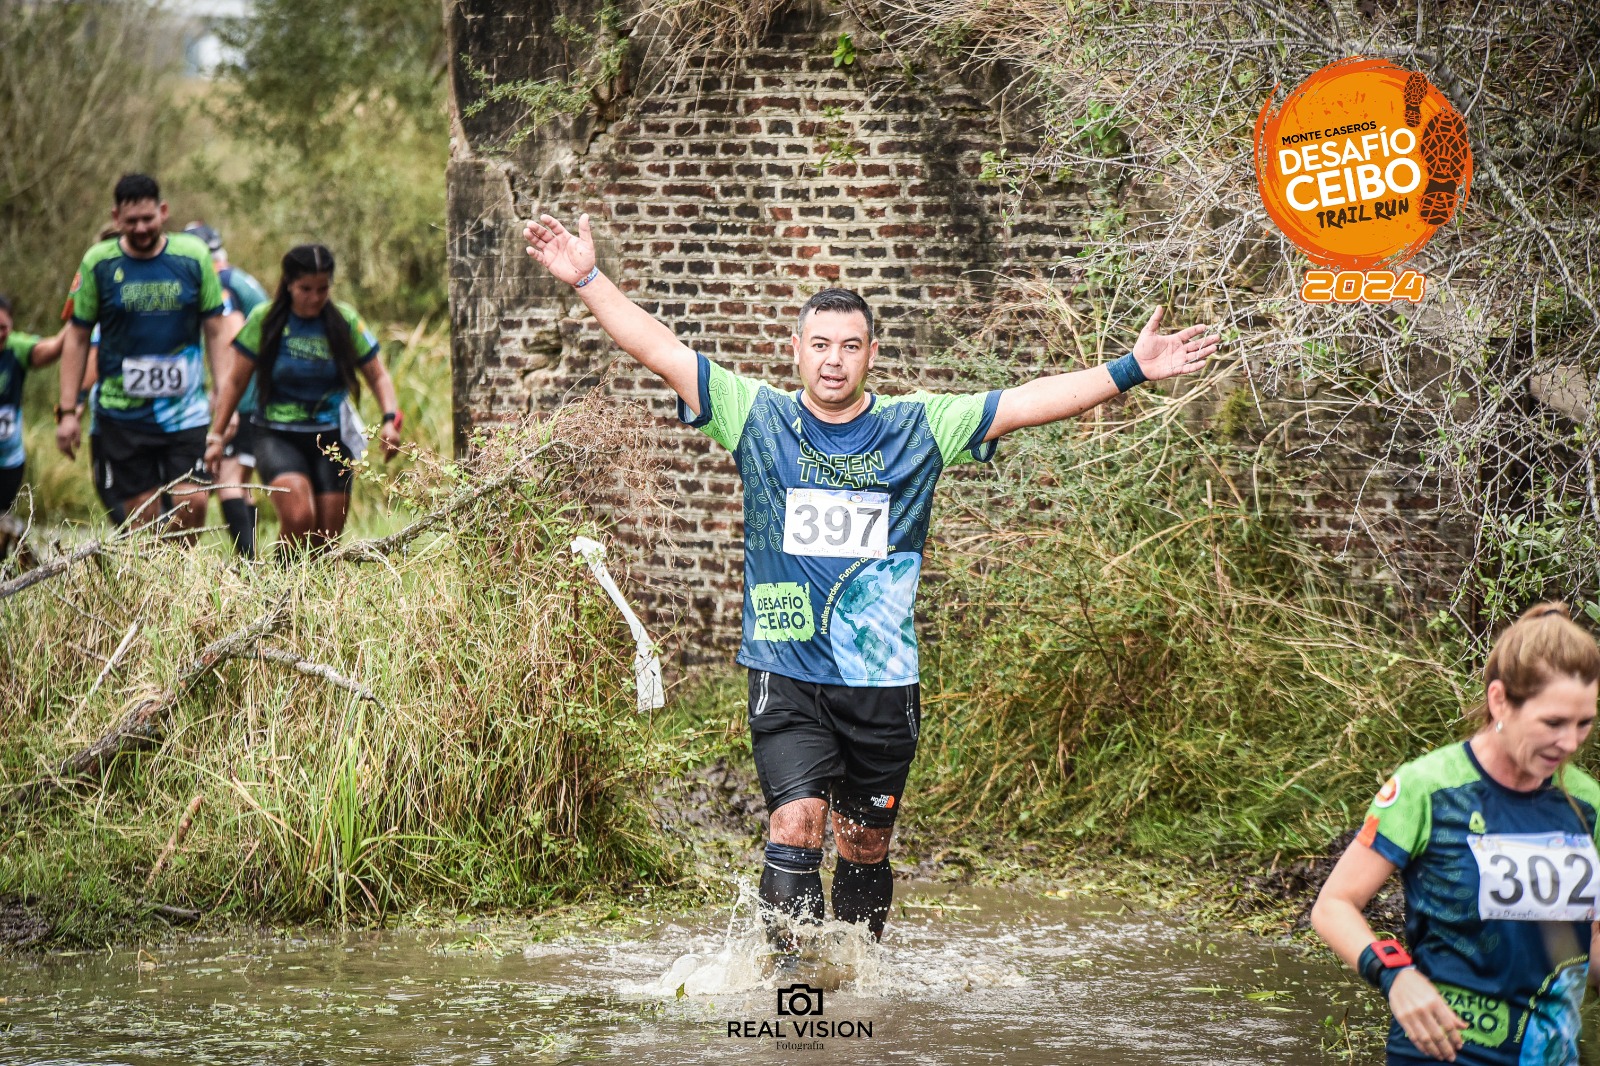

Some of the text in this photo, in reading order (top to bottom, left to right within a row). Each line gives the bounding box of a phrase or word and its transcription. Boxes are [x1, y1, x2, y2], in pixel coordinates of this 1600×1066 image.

[128, 366, 182, 391] 289
[797, 457, 890, 488] TRAIL
[800, 439, 885, 474] GREEN
[792, 504, 883, 548] 397
[757, 592, 804, 612] DESAFÍO
[820, 606, 831, 634] Huellas
[838, 561, 861, 582] Futuro
[757, 612, 806, 631] CEIBO
[1489, 854, 1596, 906] 302
